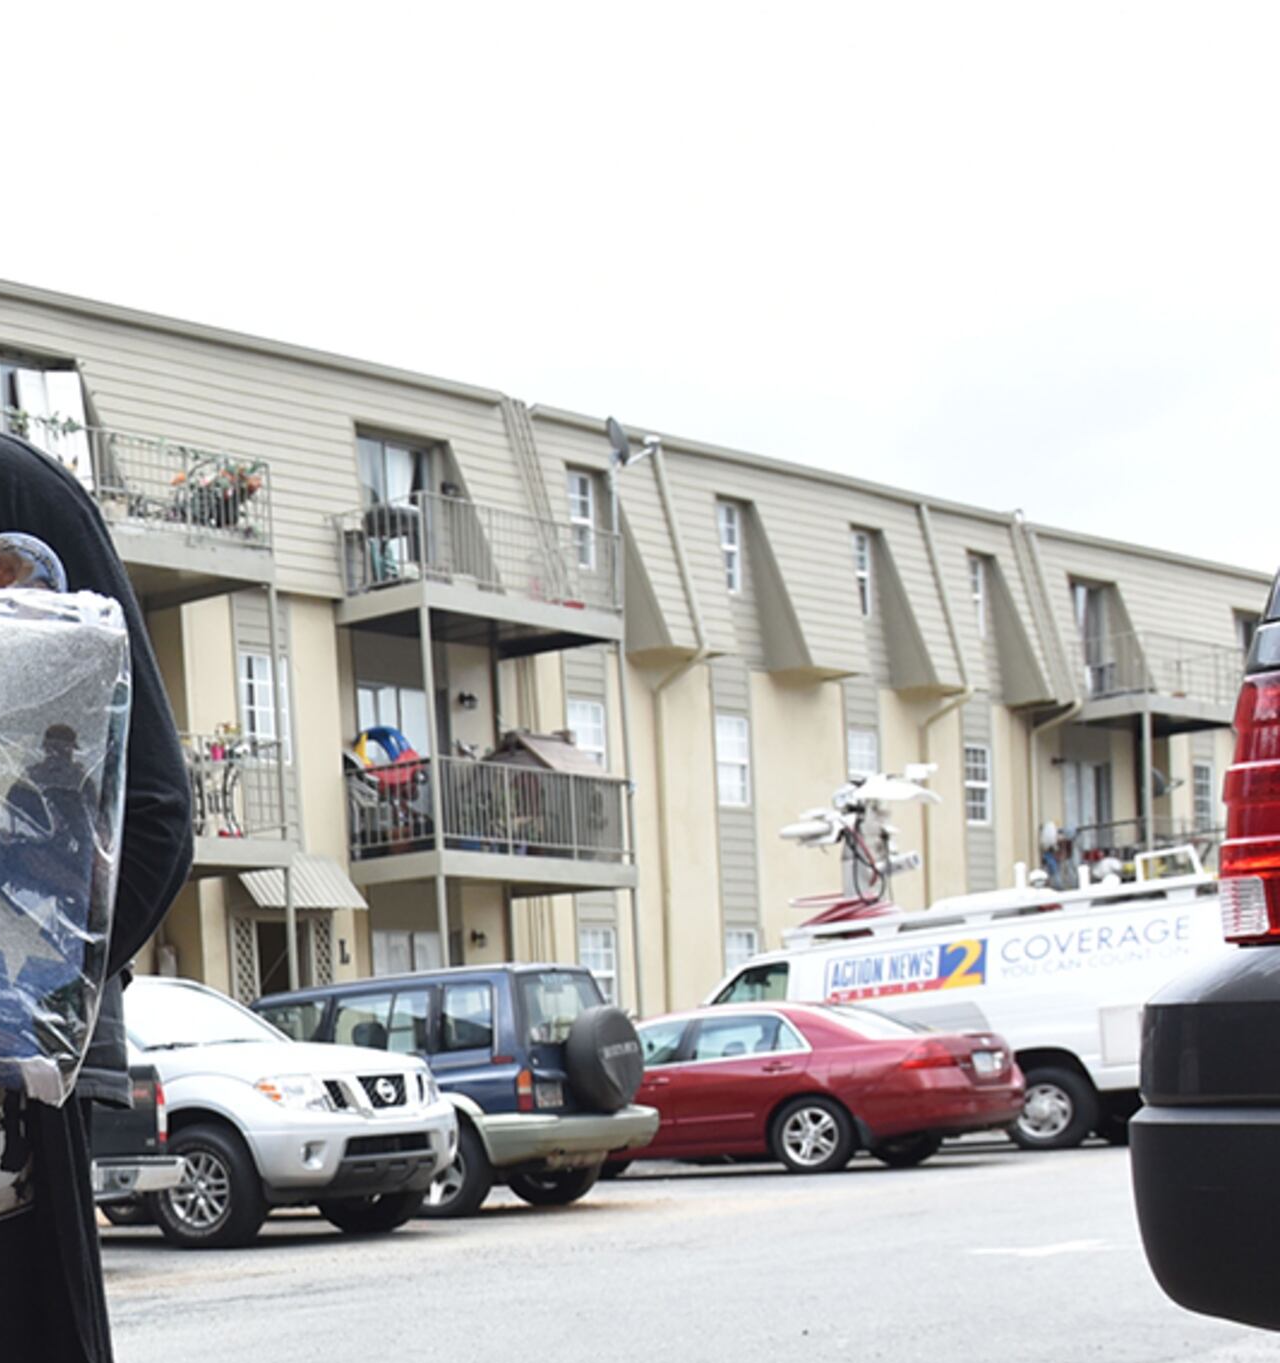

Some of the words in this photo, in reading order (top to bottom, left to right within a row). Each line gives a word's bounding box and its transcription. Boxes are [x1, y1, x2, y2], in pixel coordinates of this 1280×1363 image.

[1001, 915, 1190, 963] COVERAGE
[831, 957, 884, 988] ACTION
[888, 950, 934, 982] NEWS
[942, 939, 982, 989] 2
[1000, 963, 1036, 978] YOU
[1043, 959, 1081, 974] CAN
[1089, 949, 1150, 968] COUNT
